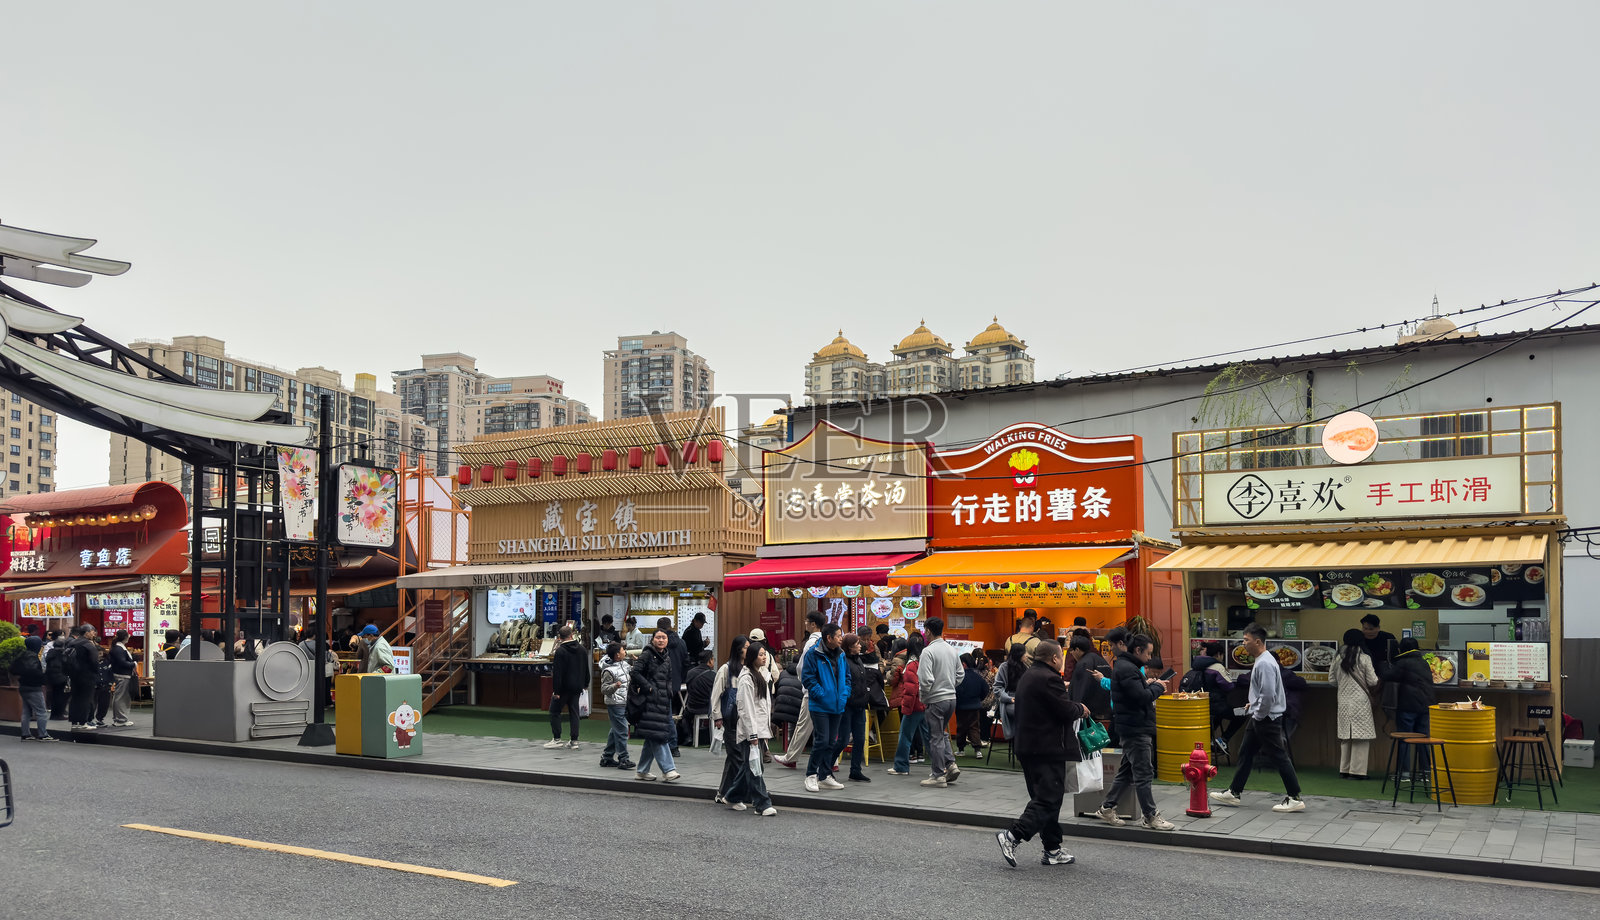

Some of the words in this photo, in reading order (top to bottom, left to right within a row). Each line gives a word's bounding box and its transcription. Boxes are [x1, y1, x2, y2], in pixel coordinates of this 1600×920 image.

[984, 431, 1036, 455] WALKING
[1038, 432, 1068, 450] FRIES
[1367, 476, 1492, 506] 手工虾滑
[542, 499, 638, 537] 藏宝镇
[951, 486, 1112, 526] 行走的薯条
[498, 536, 577, 555] SHANGHAI
[581, 529, 692, 551] SILVERSMITH
[80, 547, 132, 568] 章鱼烧
[472, 573, 514, 585] SHANGHAI
[517, 571, 574, 584] SILVERSMITH
